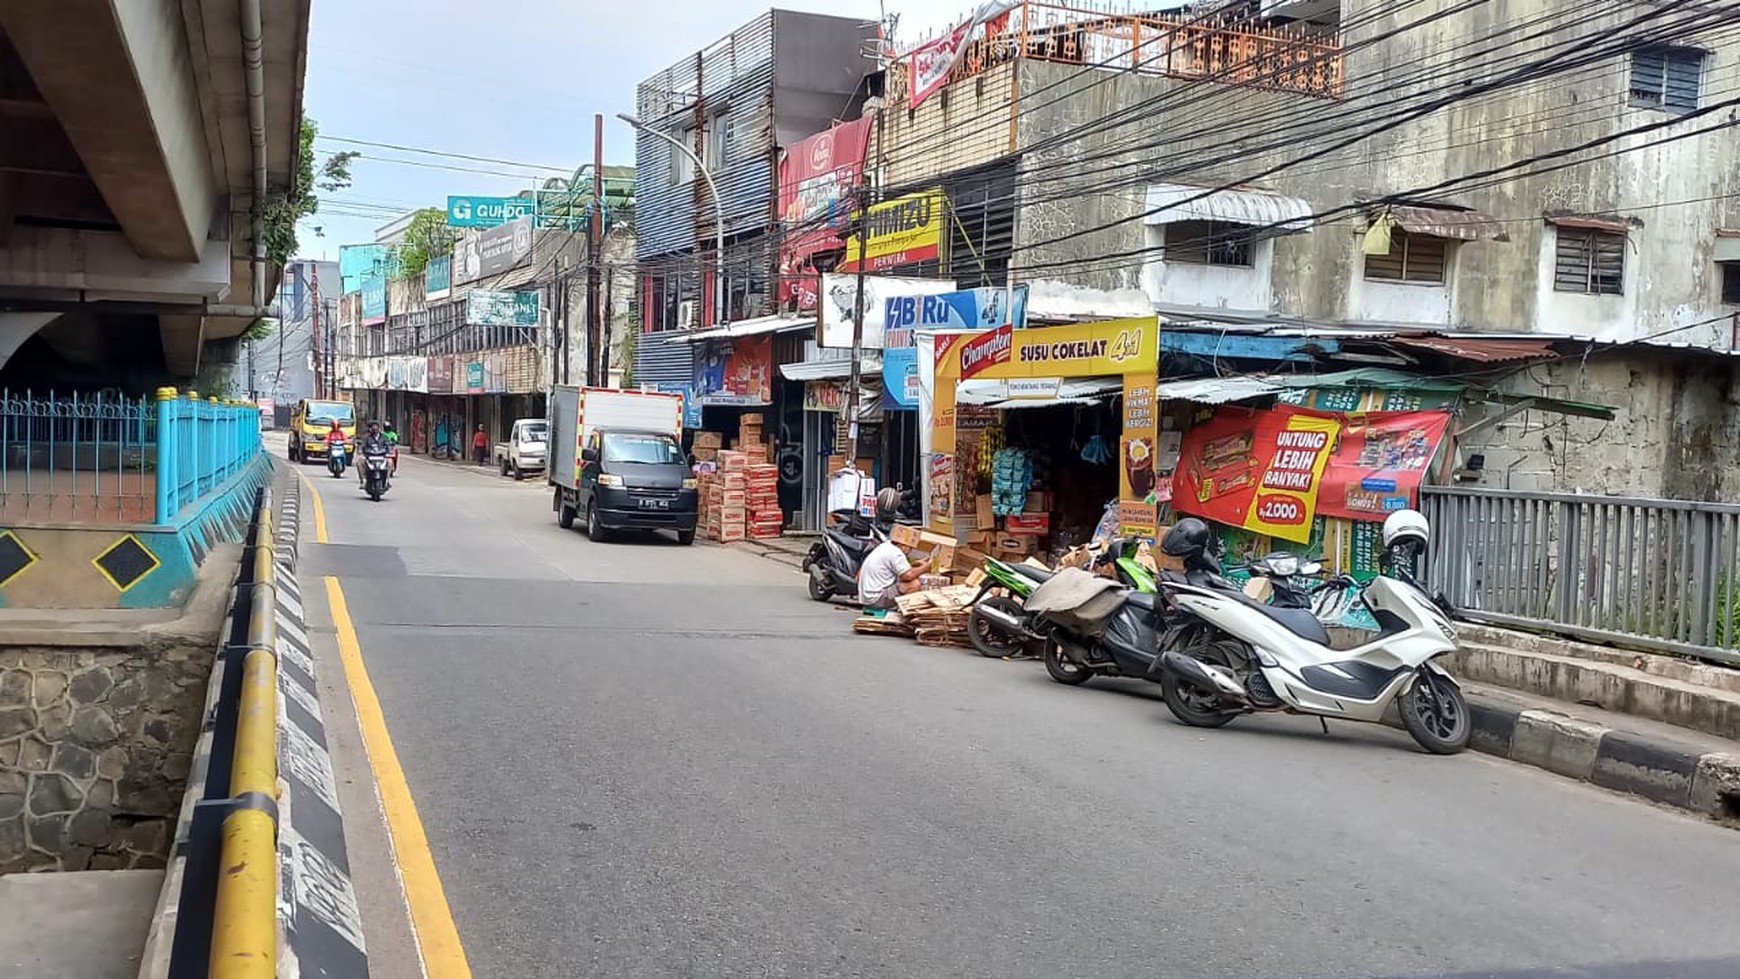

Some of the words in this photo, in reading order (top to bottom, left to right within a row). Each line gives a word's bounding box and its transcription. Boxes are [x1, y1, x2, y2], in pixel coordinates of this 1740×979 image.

[873, 252, 906, 268] PERWIRA
[962, 330, 1011, 370] Champion
[1020, 345, 1049, 362] SUSU
[1051, 340, 1107, 360] COKELAT
[1276, 431, 1326, 449] UNTUNG
[1273, 449, 1316, 471] LEBIH
[1263, 470, 1312, 489] BANYAK!
[1364, 519, 1372, 538] AK
